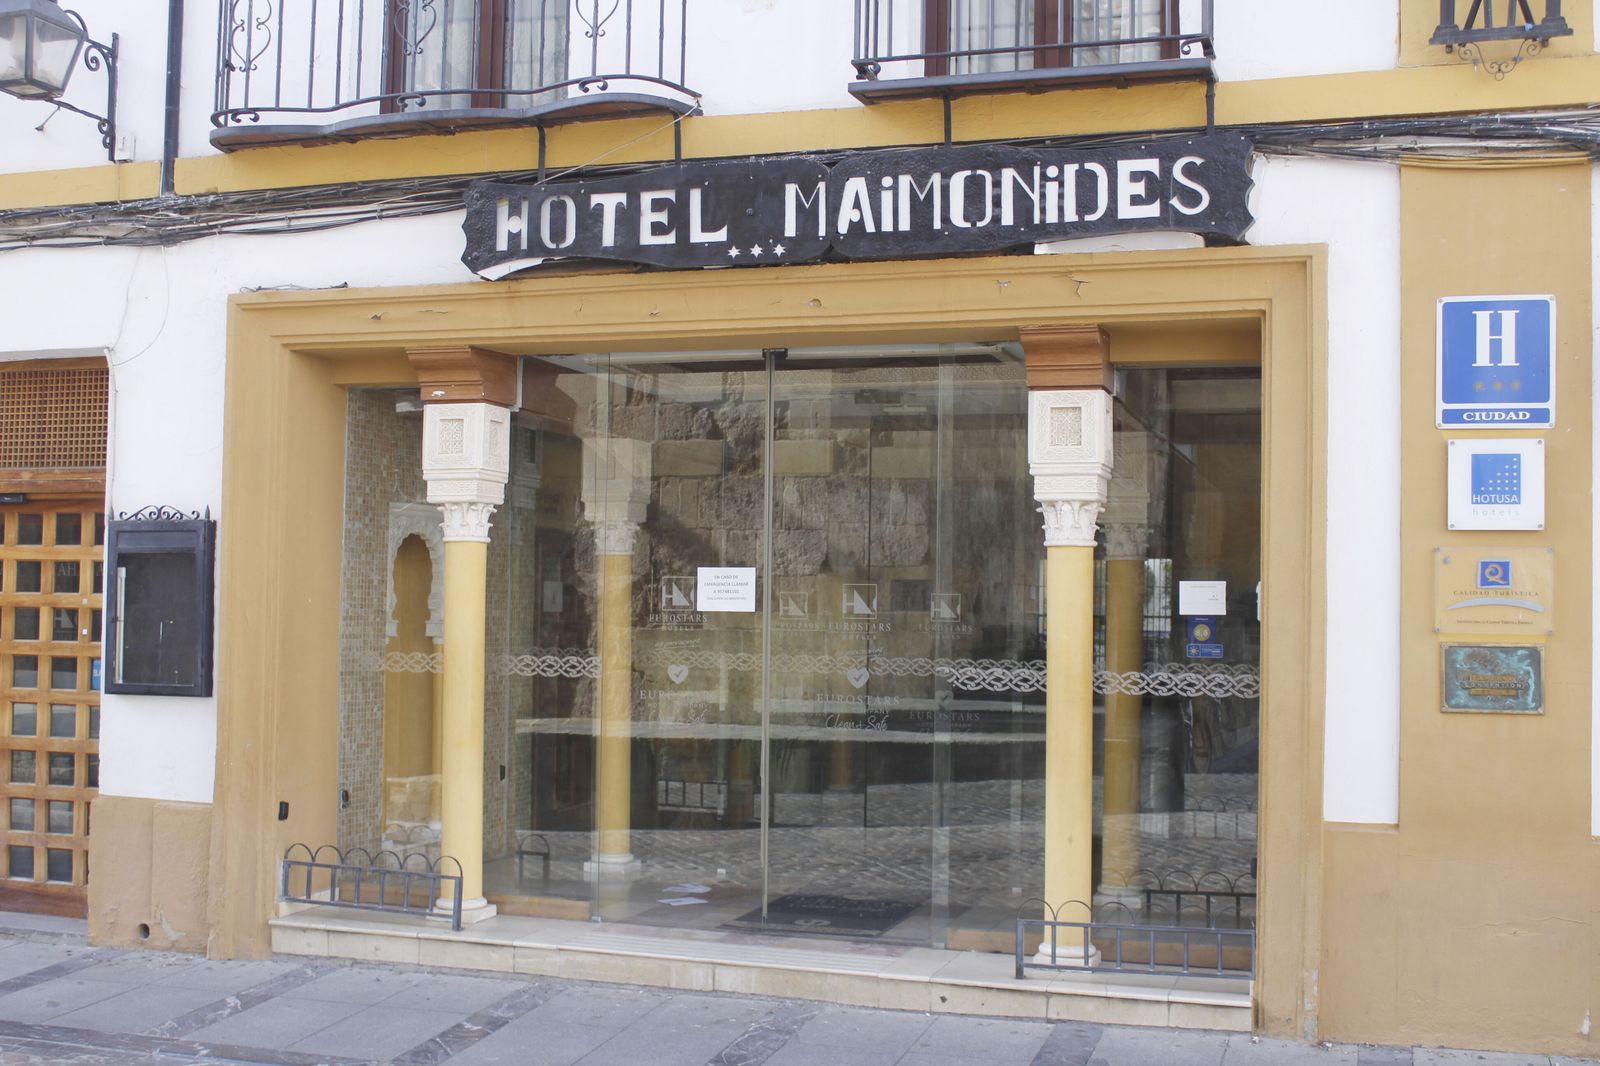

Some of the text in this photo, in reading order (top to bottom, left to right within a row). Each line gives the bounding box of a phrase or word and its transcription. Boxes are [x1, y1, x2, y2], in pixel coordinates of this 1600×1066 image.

[496, 187, 728, 251] HOTEL
[1472, 310, 1519, 367] H
[1462, 411, 1531, 421] CIUDAD
[1472, 494, 1519, 504] HOTUSA
[1472, 507, 1520, 516] hotels
[1484, 564, 1508, 584] Q
[649, 613, 707, 623] EUROSTARS
[828, 622, 891, 632] EUROSTARS
[817, 694, 900, 705] EUROSTARS
